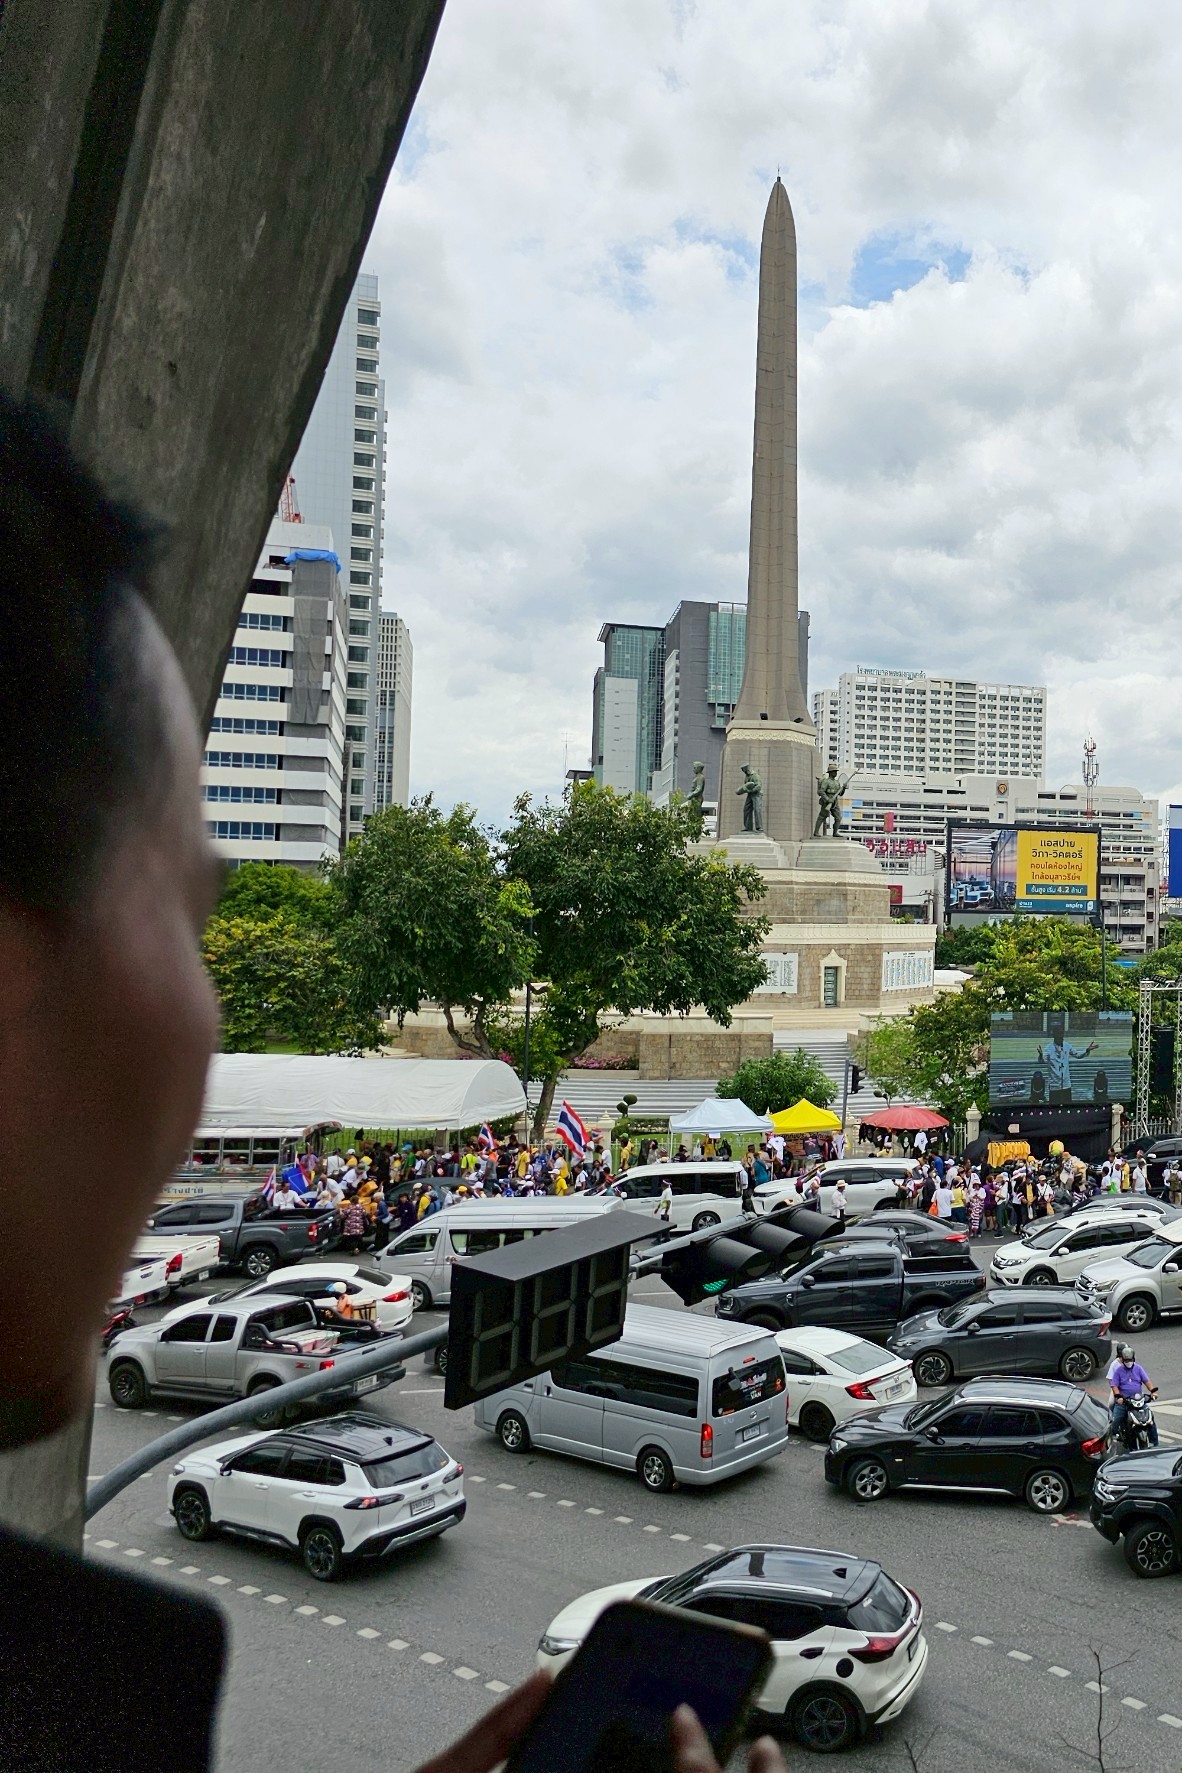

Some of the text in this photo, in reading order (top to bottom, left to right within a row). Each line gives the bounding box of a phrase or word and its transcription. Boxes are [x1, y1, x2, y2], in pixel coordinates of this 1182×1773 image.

[1040, 839, 1076, 848] แอสปาย
[1032, 847, 1083, 859] วิภา-วิคตอรี่
